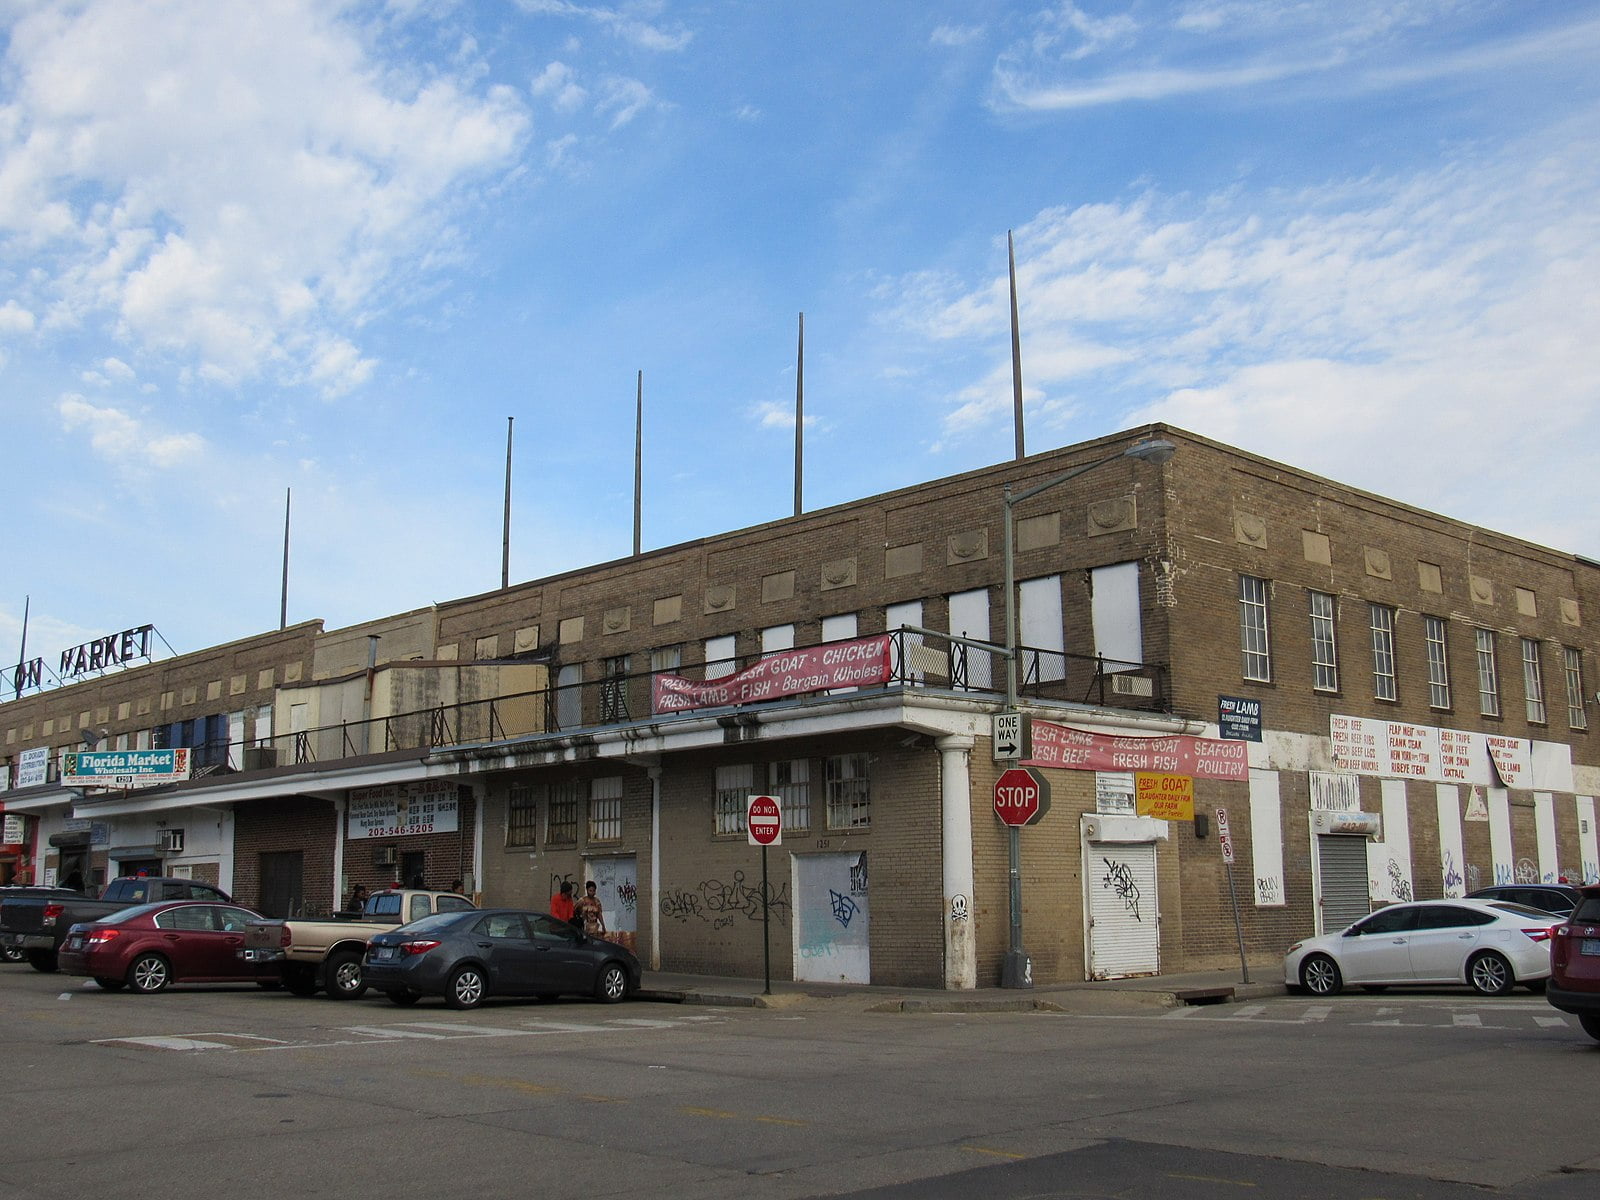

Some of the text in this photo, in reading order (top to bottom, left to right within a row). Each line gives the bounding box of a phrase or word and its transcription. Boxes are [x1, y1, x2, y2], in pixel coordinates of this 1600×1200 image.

[60, 624, 153, 675] MARKET
[660, 678, 692, 692] FRESH
[770, 654, 809, 674] GOAT
[823, 640, 884, 665] CHICKEN
[658, 694, 691, 709] FRESH
[693, 685, 729, 705] LAMB
[741, 680, 770, 699] FISH
[782, 673, 829, 692] Bargain
[1220, 700, 1259, 716] FRESH LAMB
[998, 717, 1017, 728] ONE
[1333, 718, 1362, 731] FRESH BEEF
[998, 729, 1018, 740] WAY
[1389, 724, 1401, 735] FLAP
[1333, 731, 1348, 742] FRESH
[1351, 733, 1362, 744] BEEF
[1390, 737, 1407, 748] FLANK
[1441, 731, 1471, 744] BEEF TRIPE
[1061, 731, 1094, 746] LAMB
[1113, 738, 1147, 750] FRESH
[1152, 739, 1180, 753] GOAT
[1194, 742, 1243, 758] SEAFOOD
[1441, 744, 1468, 755] COW FEET
[1334, 745, 1349, 756] FRESH
[1351, 746, 1363, 757] BEEF
[1391, 750, 1400, 760] NEW
[81, 753, 172, 768] Florida Market
[1062, 748, 1091, 764] BEEF
[1112, 752, 1148, 768] FRESH
[1153, 755, 1178, 771] FISH
[1196, 759, 1244, 776] POULTRY
[1335, 760, 1349, 769] FRESH
[1350, 760, 1360, 770] BEEF
[1442, 756, 1470, 767] COW SKIN
[1391, 762, 1410, 773] RIBEYE
[1507, 762, 1521, 772] LAMB
[1443, 768, 1465, 779] OXTAIL
[1139, 777, 1190, 791] FRESH GOAT
[352, 787, 395, 800] Super Food Inc.
[997, 787, 1035, 807] STOP
[1139, 792, 1167, 800] SLAUGHTER
[1167, 793, 1180, 801] DAILY
[752, 806, 775, 814] DO NOT
[1154, 801, 1163, 809] OUR
[368, 824, 434, 837] 202-546-5205
[755, 827, 774, 835] ENTER
[816, 840, 830, 848] 1251
